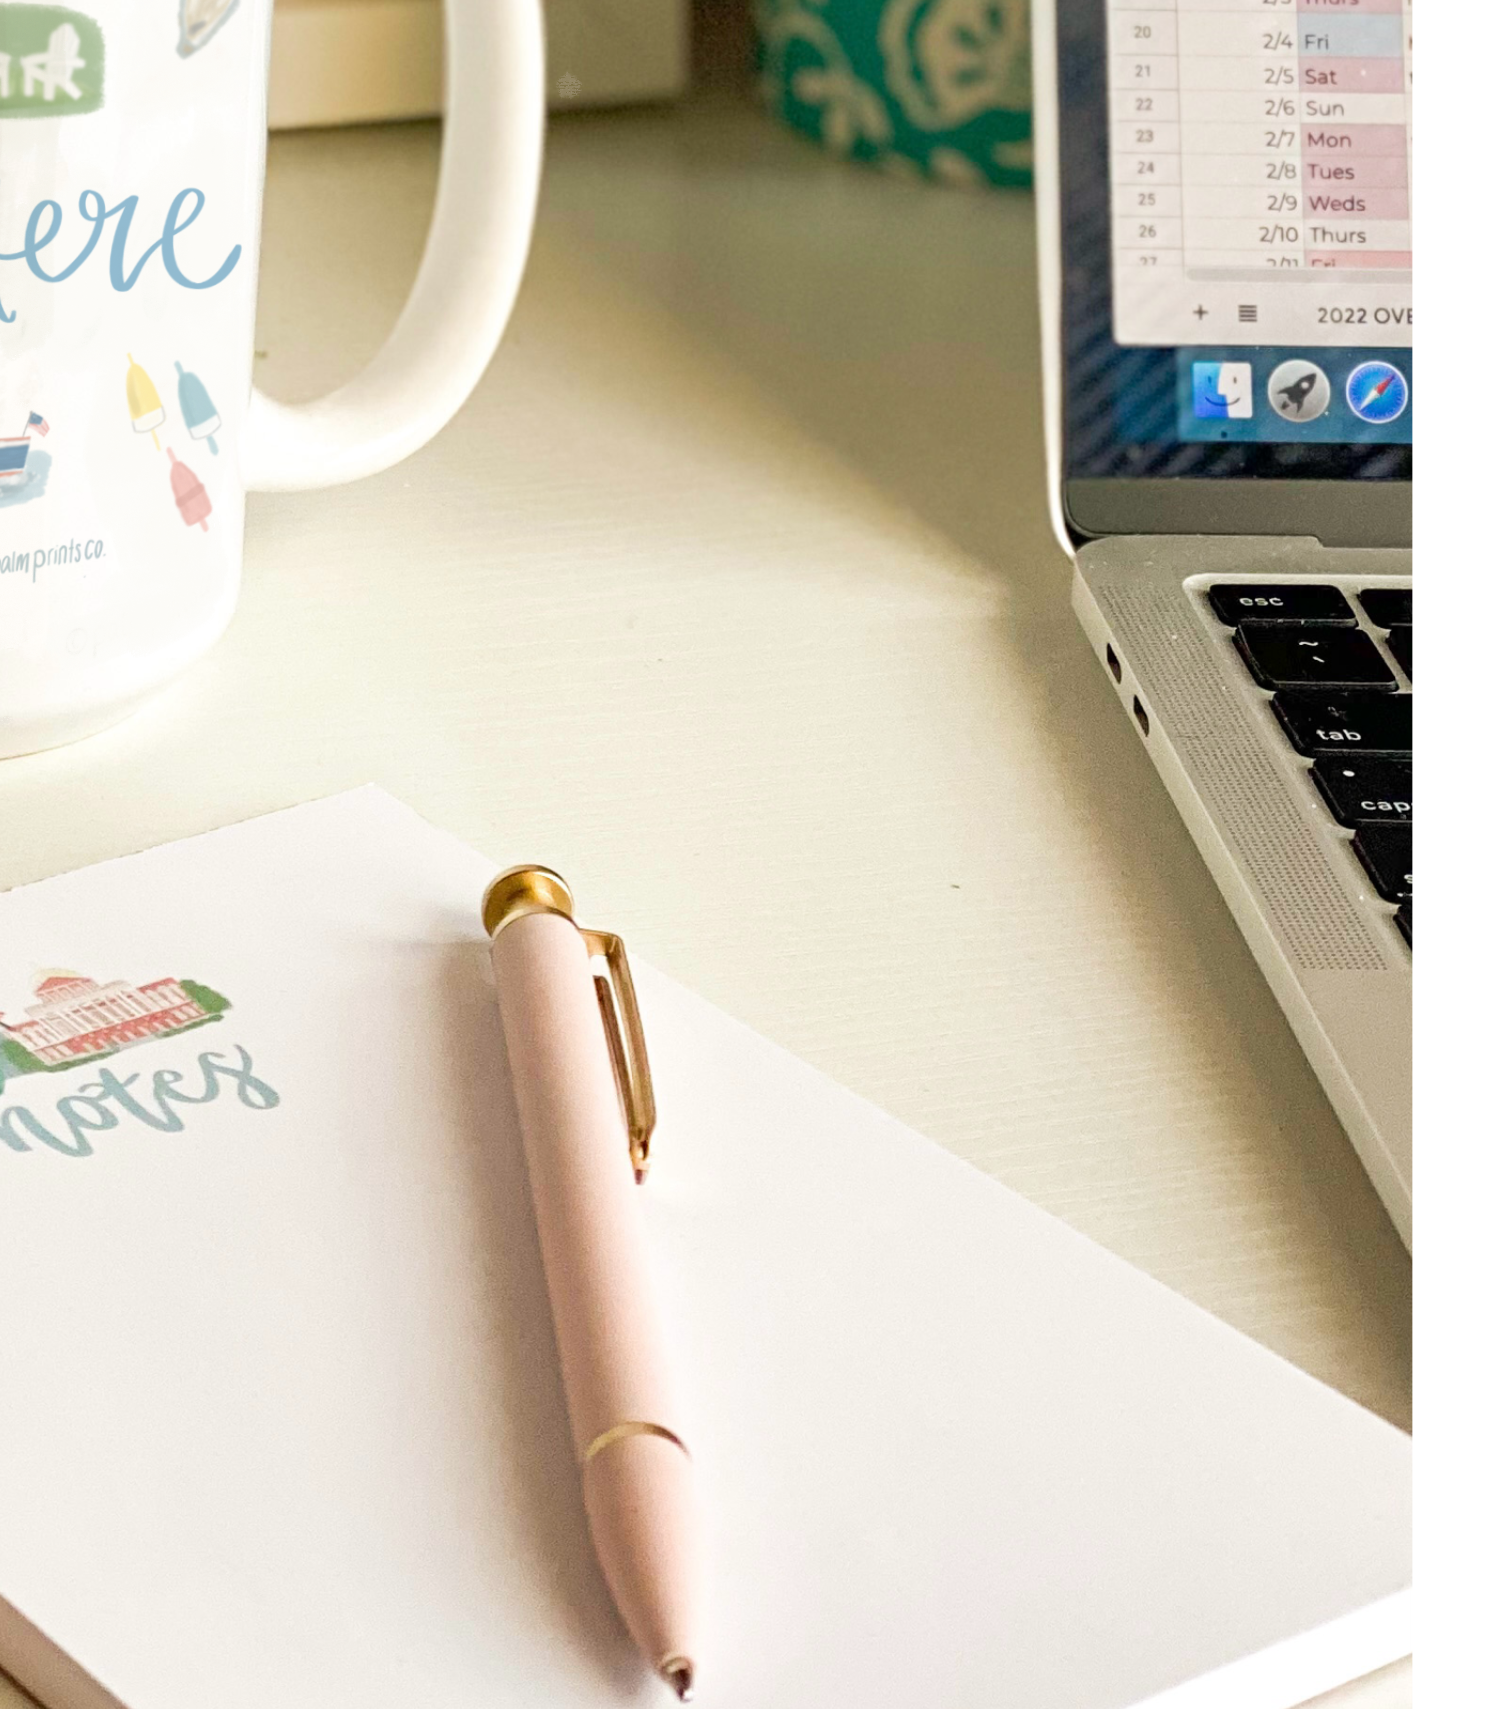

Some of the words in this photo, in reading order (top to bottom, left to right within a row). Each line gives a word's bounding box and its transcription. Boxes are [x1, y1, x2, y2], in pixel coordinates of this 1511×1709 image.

[1134, 26, 1152, 38] 20
[1263, 34, 1293, 51] 2/4
[1304, 34, 1329, 50] Fri
[1135, 65, 1151, 77] 21
[1264, 68, 1294, 85] 2/5
[1304, 68, 1338, 85] Sat
[1136, 98, 1153, 111] 22
[1264, 99, 1295, 117] 2/6
[1305, 100, 1344, 116] Sun
[1136, 130, 1154, 142] 23
[1265, 132, 1295, 148] 2/7
[1307, 132, 1352, 148] Mon
[1137, 161, 1155, 174] 24
[1266, 163, 1297, 180] 2/8
[1307, 163, 1355, 180] Tues
[1138, 193, 1156, 206] 25
[1267, 195, 1297, 212] 2/9
[1309, 195, 1366, 212] Weds
[1139, 225, 1156, 238] 26
[1259, 226, 1298, 244] 2/10
[1309, 227, 1367, 243] Thurs
[1317, 307, 1368, 324] 2022
[1239, 597, 1284, 607] esc
[1316, 729, 1361, 742] tab
[1361, 800, 1412, 813] cap
